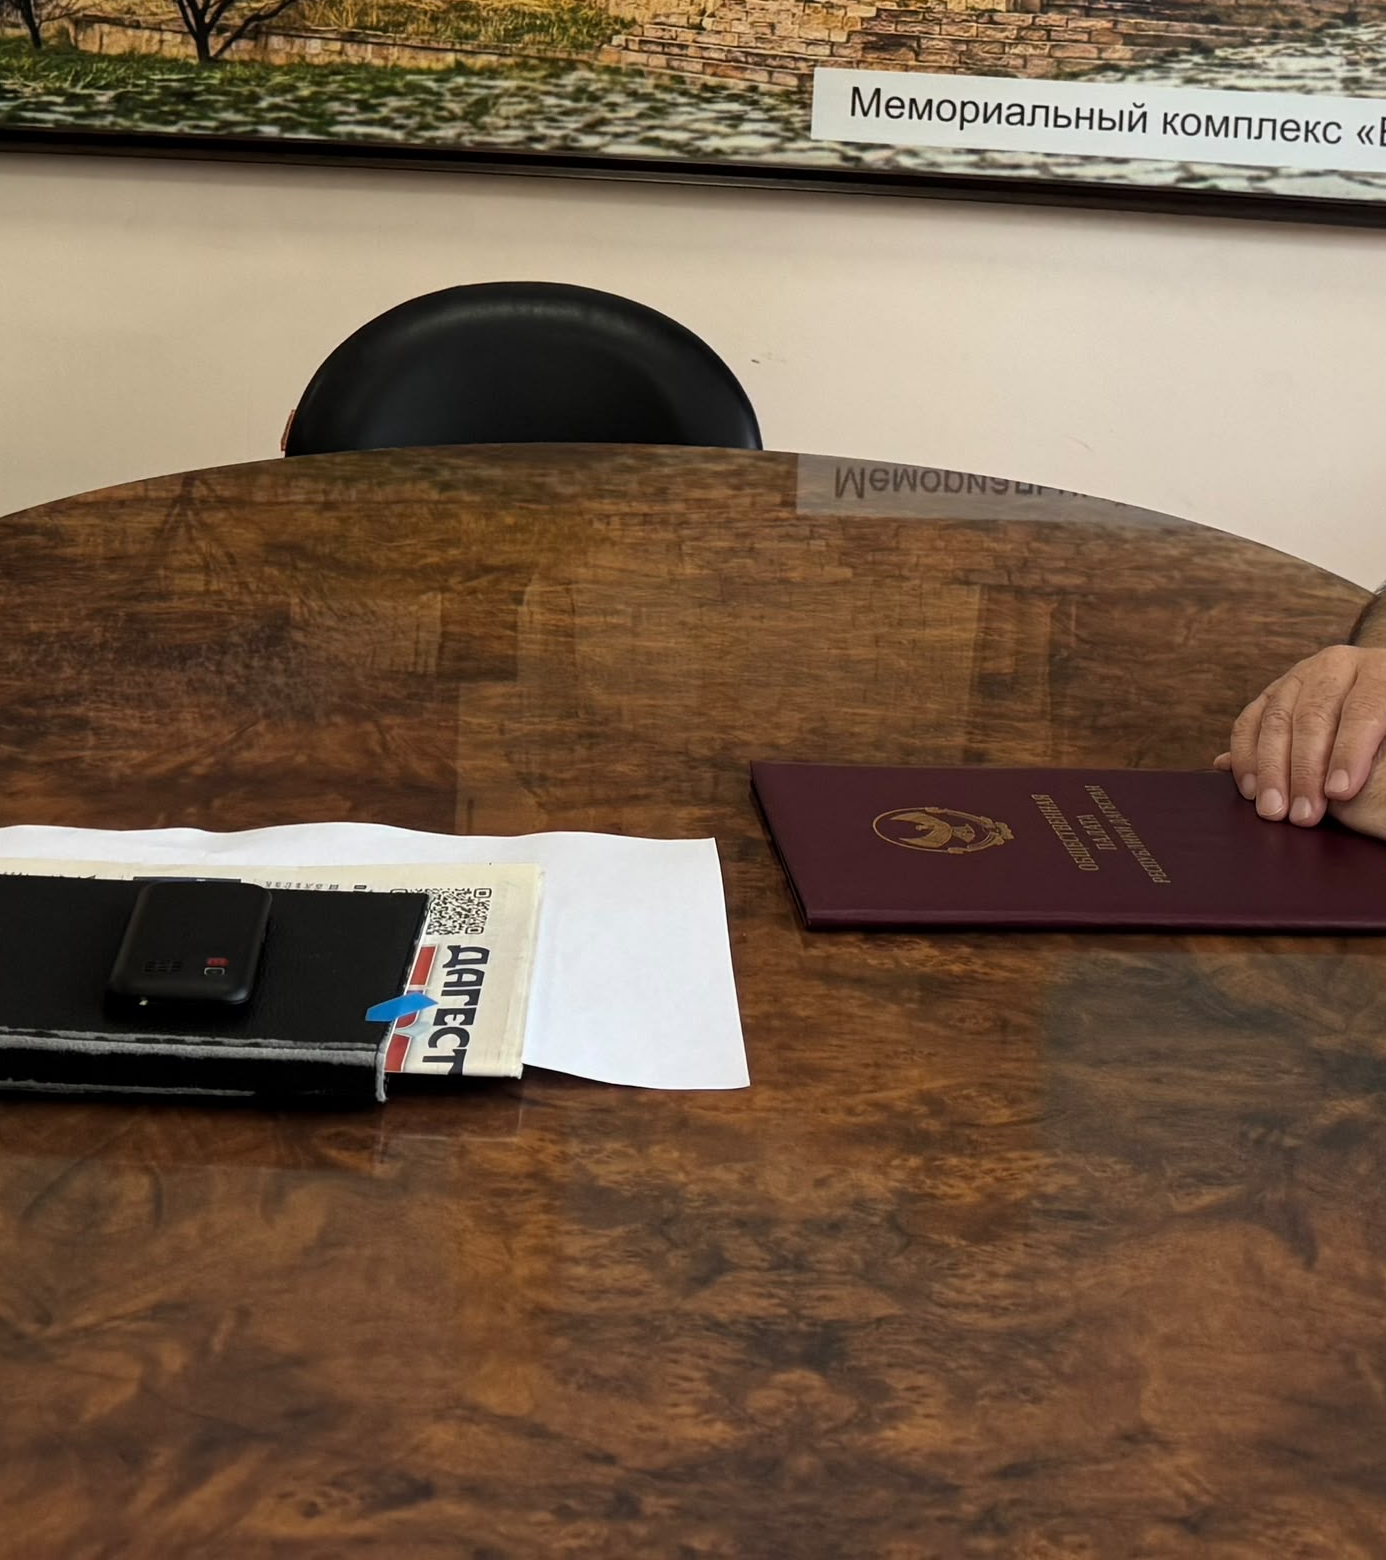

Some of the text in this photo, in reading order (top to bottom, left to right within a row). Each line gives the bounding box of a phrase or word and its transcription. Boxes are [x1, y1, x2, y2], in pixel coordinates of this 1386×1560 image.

[849, 86, 1148, 134] Мемориальный
[1162, 111, 1343, 144] комплекс
[1031, 794, 1100, 871] ОБЩЕСТВЕННАЯ
[1076, 814, 1117, 851] ПАЛАТА
